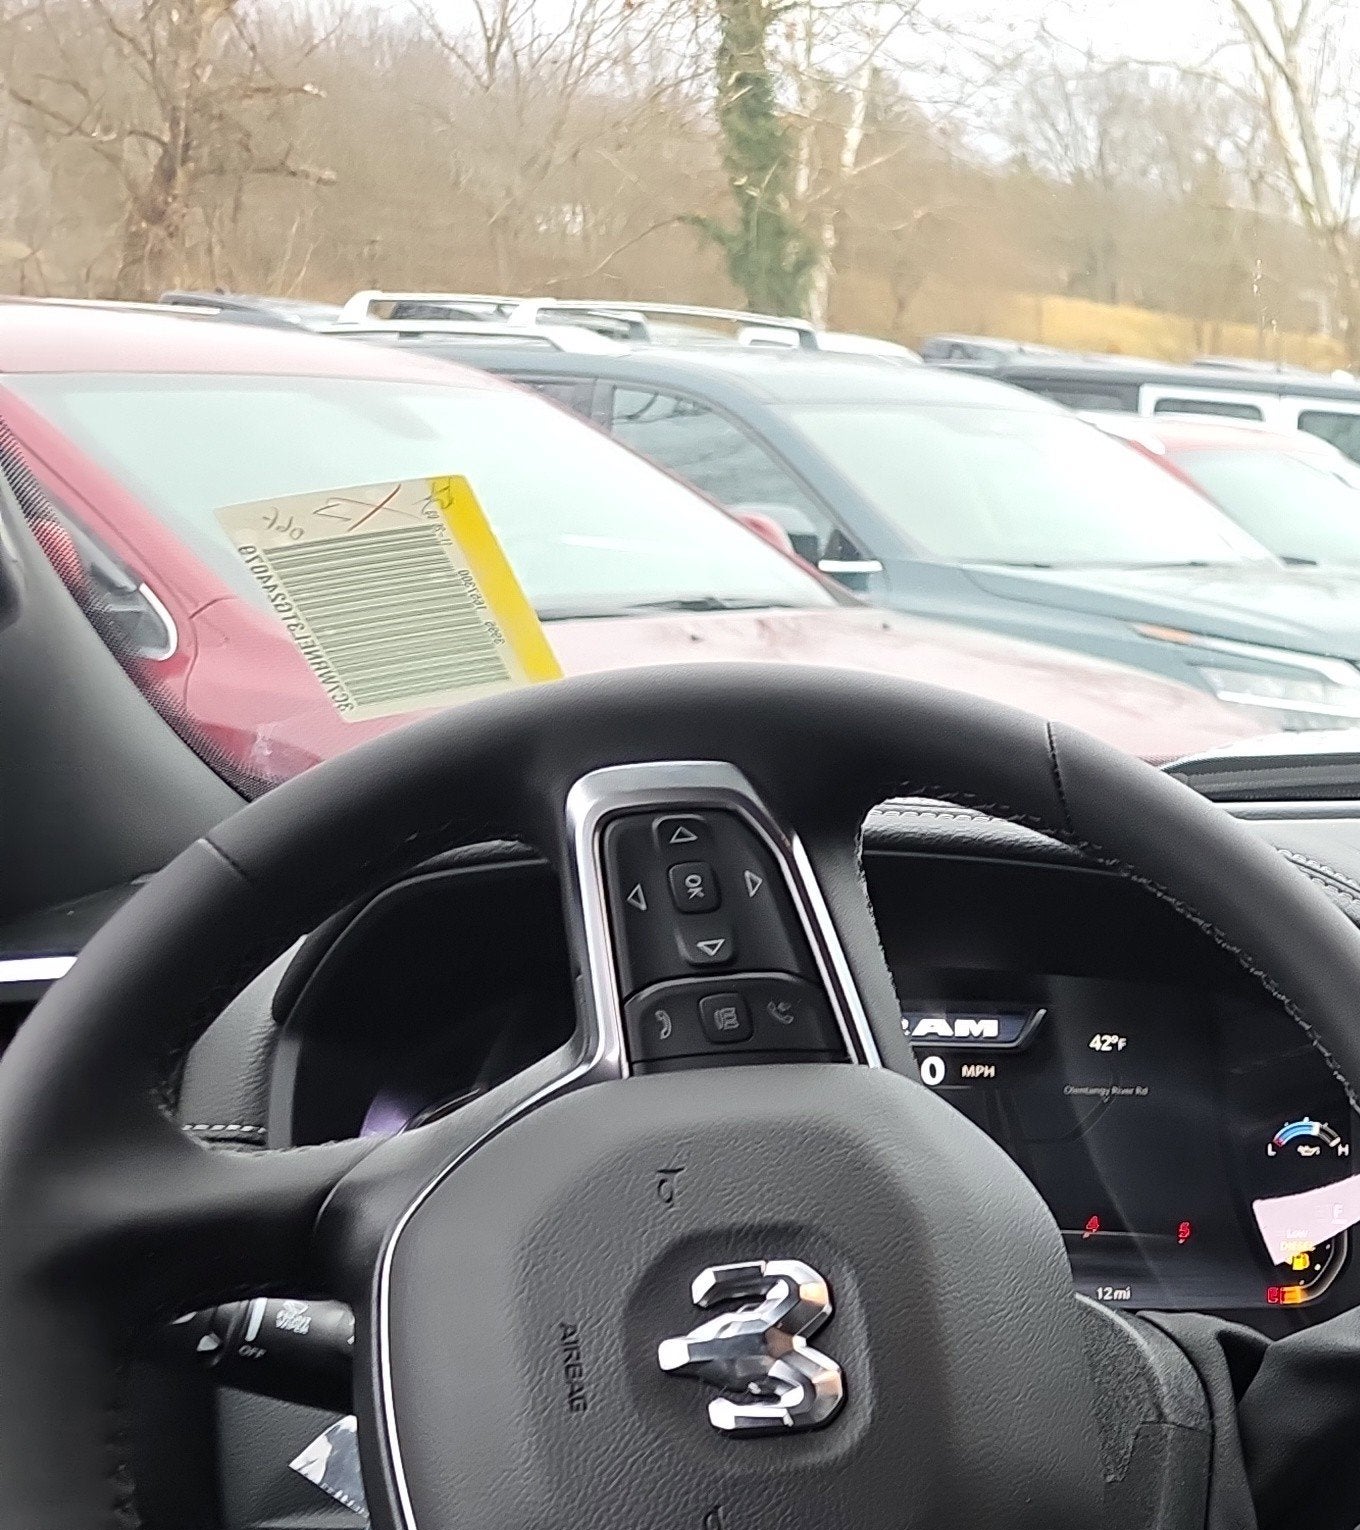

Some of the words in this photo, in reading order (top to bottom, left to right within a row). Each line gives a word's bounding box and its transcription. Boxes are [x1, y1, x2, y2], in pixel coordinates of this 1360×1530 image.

[685, 874, 704, 899] OK
[920, 1056, 946, 1086] 0
[961, 1064, 996, 1078] MPH
[1267, 1143, 1276, 1157] L
[1337, 1143, 1350, 1157] H
[238, 1345, 267, 1359] OFF
[559, 1322, 588, 1413] AIRBAG
